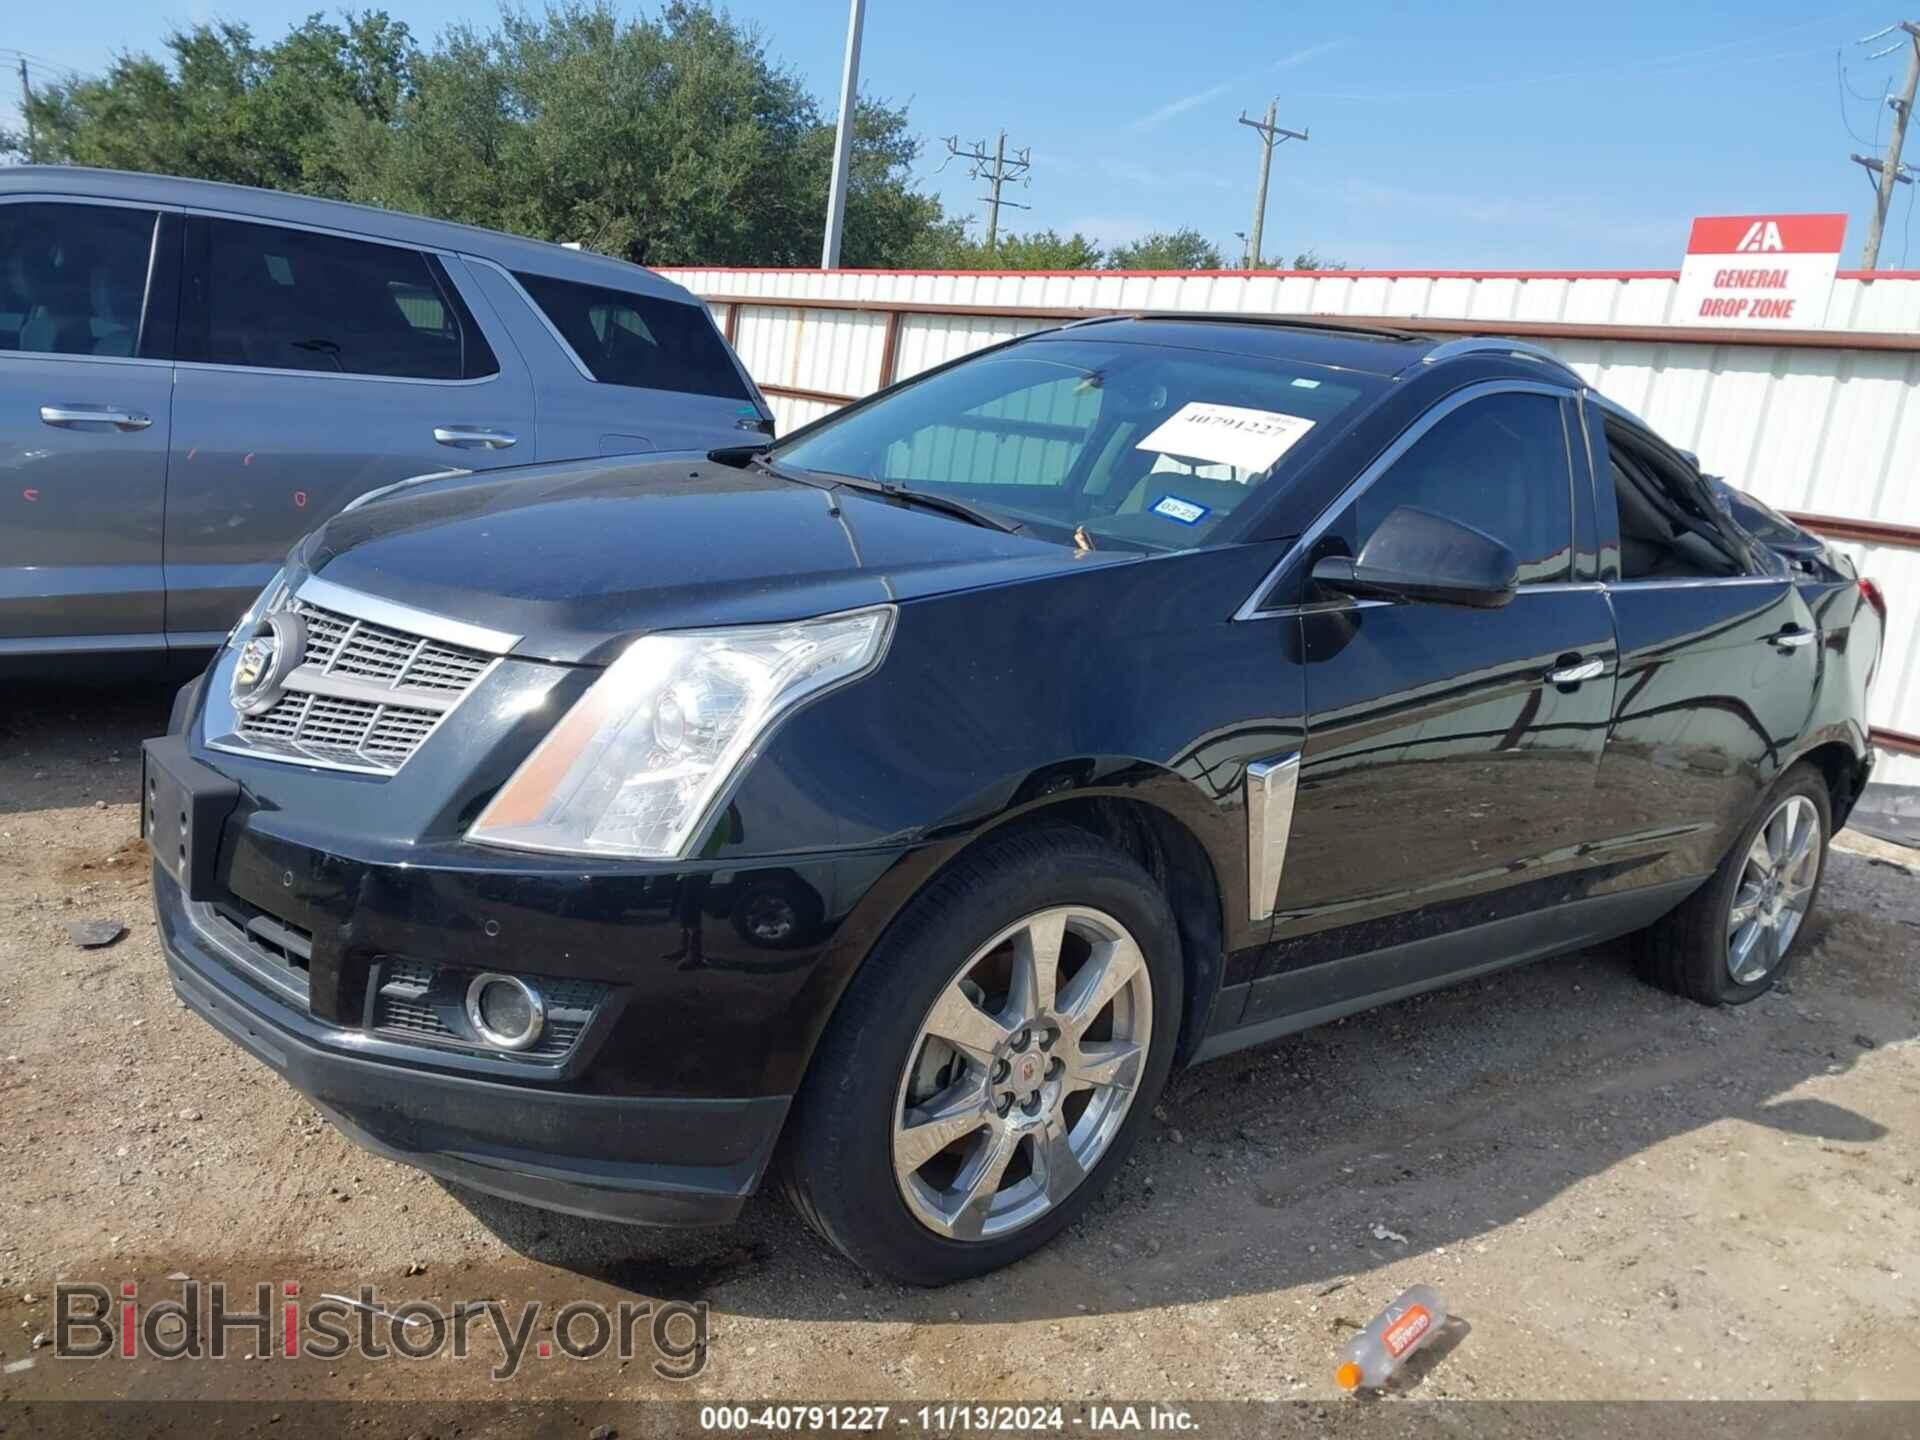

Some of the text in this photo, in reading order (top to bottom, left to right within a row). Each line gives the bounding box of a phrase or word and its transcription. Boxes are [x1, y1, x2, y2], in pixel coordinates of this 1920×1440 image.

[1713, 268, 1789, 289] GENERAL
[1699, 297, 1796, 319] DROP ZONE
[1184, 413, 1287, 437] 40791227
